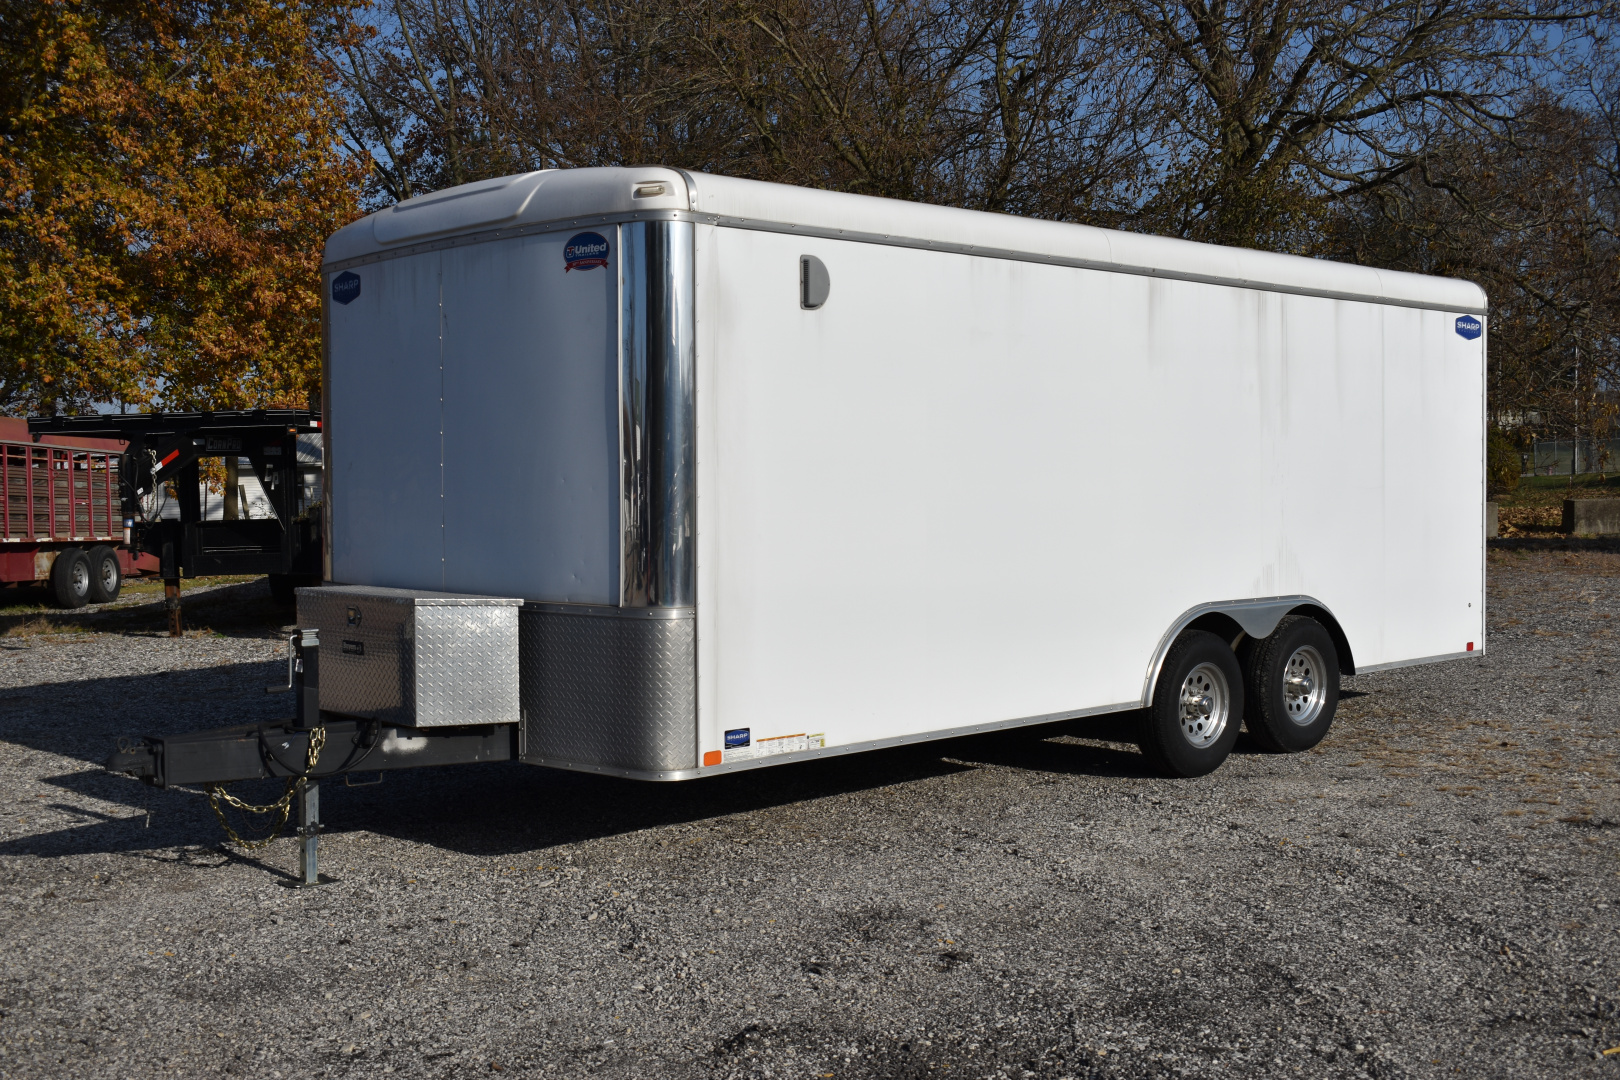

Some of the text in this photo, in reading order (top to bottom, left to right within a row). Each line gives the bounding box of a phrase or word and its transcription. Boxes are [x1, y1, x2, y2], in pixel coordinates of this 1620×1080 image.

[575, 243, 606, 254] United
[334, 279, 359, 292] SHARP
[1456, 321, 1480, 331] SHARP
